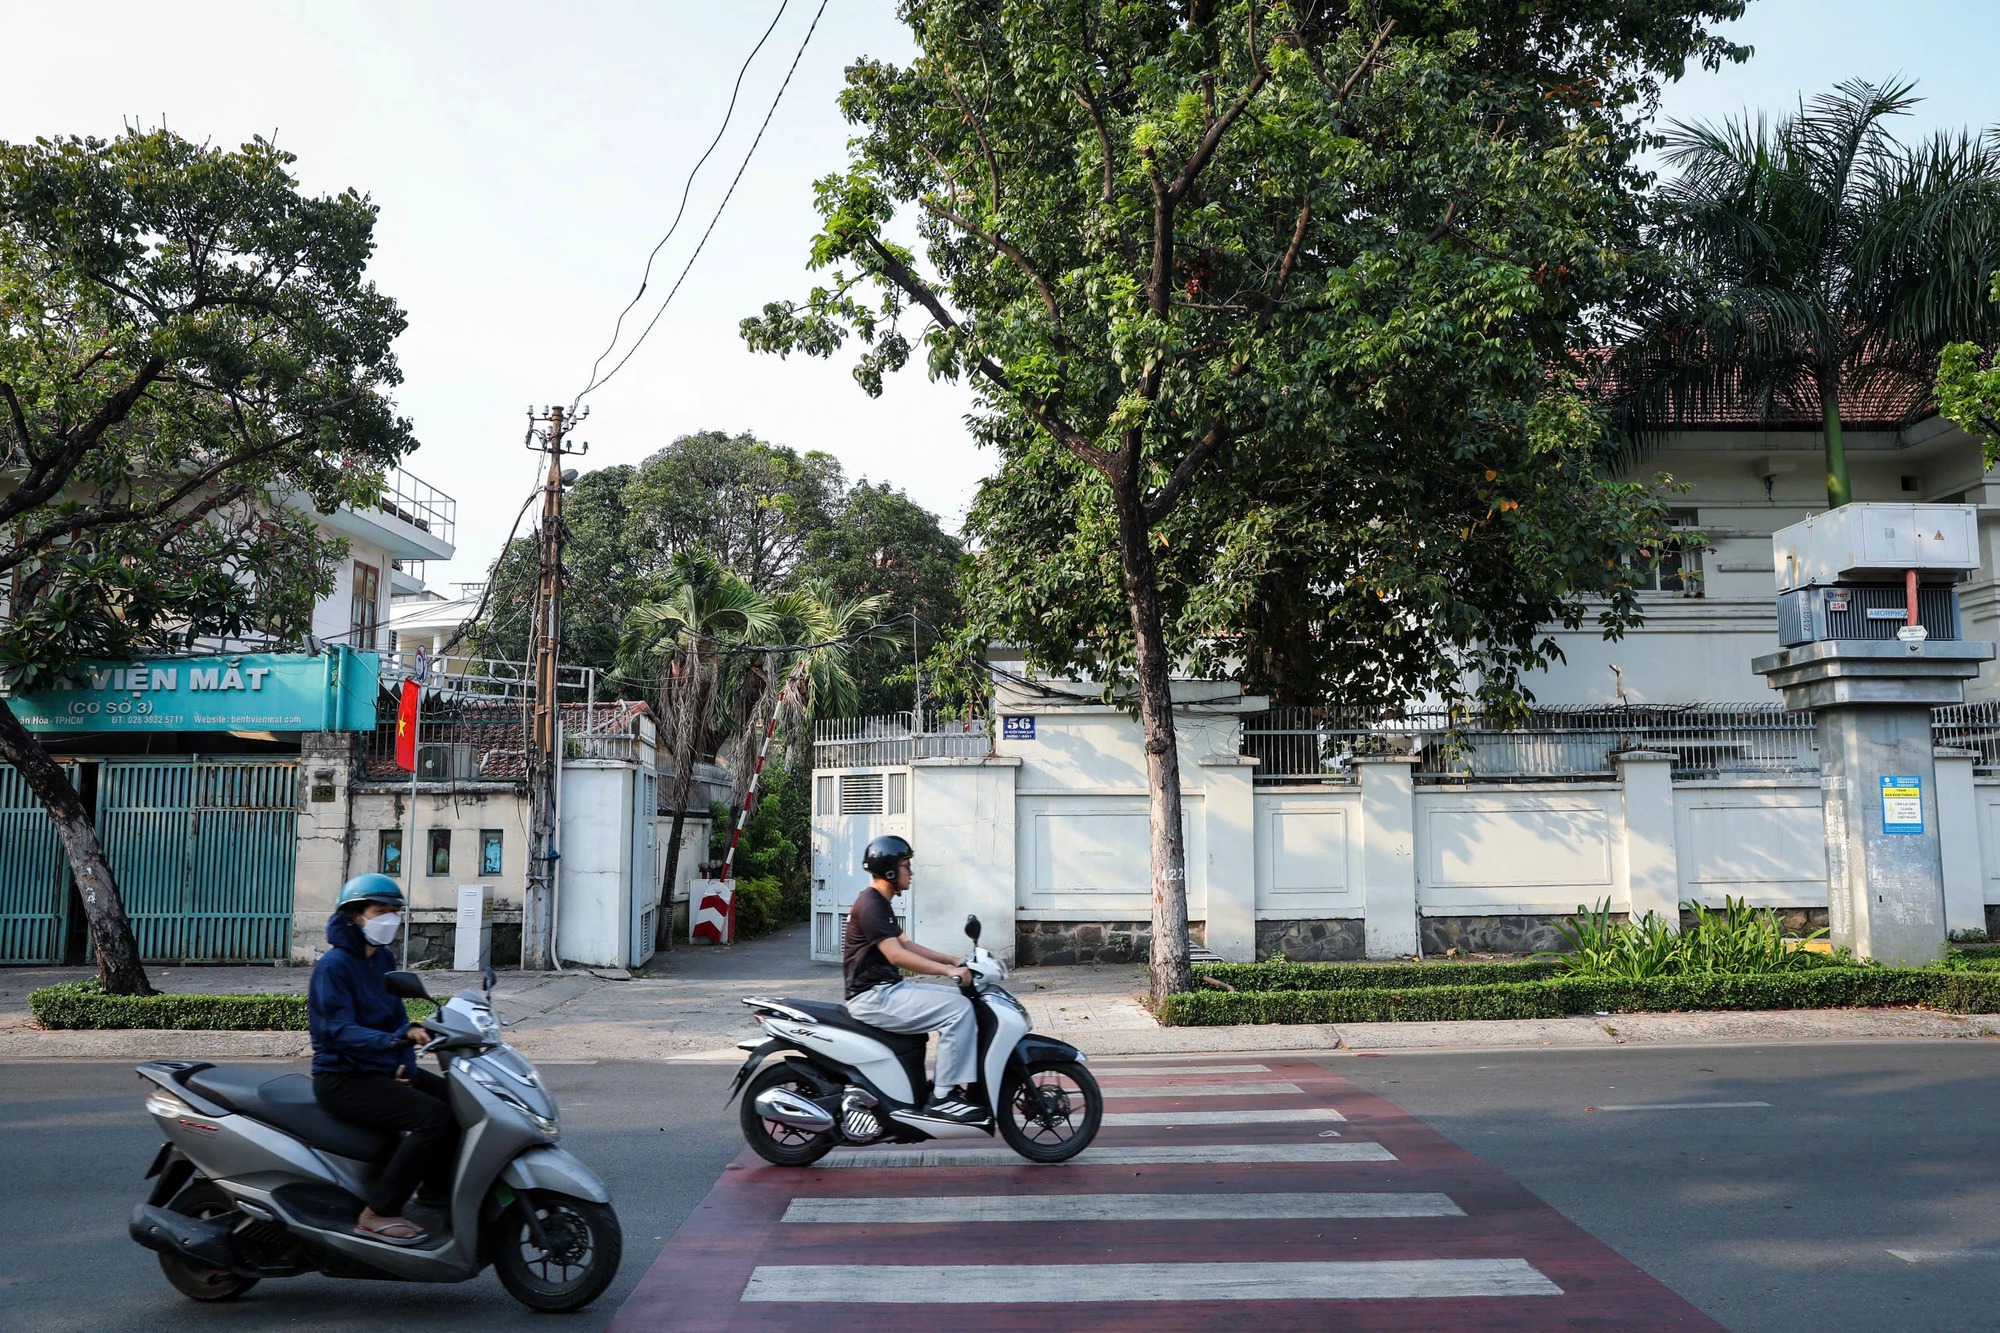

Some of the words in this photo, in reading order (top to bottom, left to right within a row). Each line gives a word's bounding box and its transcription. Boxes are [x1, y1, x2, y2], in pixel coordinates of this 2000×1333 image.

[88, 662, 177, 698] VIỆN
[189, 657, 269, 691] MẮT
[105, 697, 132, 714] SỞ
[137, 701, 154, 715] 3)
[32, 716, 49, 725] Hòa
[55, 716, 84, 725] TPHCM
[128, 715, 142, 724] 028
[144, 715, 163, 724] 3932
[165, 715, 184, 724] 5711
[194, 715, 229, 724] Website:
[1007, 717, 1031, 729] 56
[315, 786, 333, 797] 58
